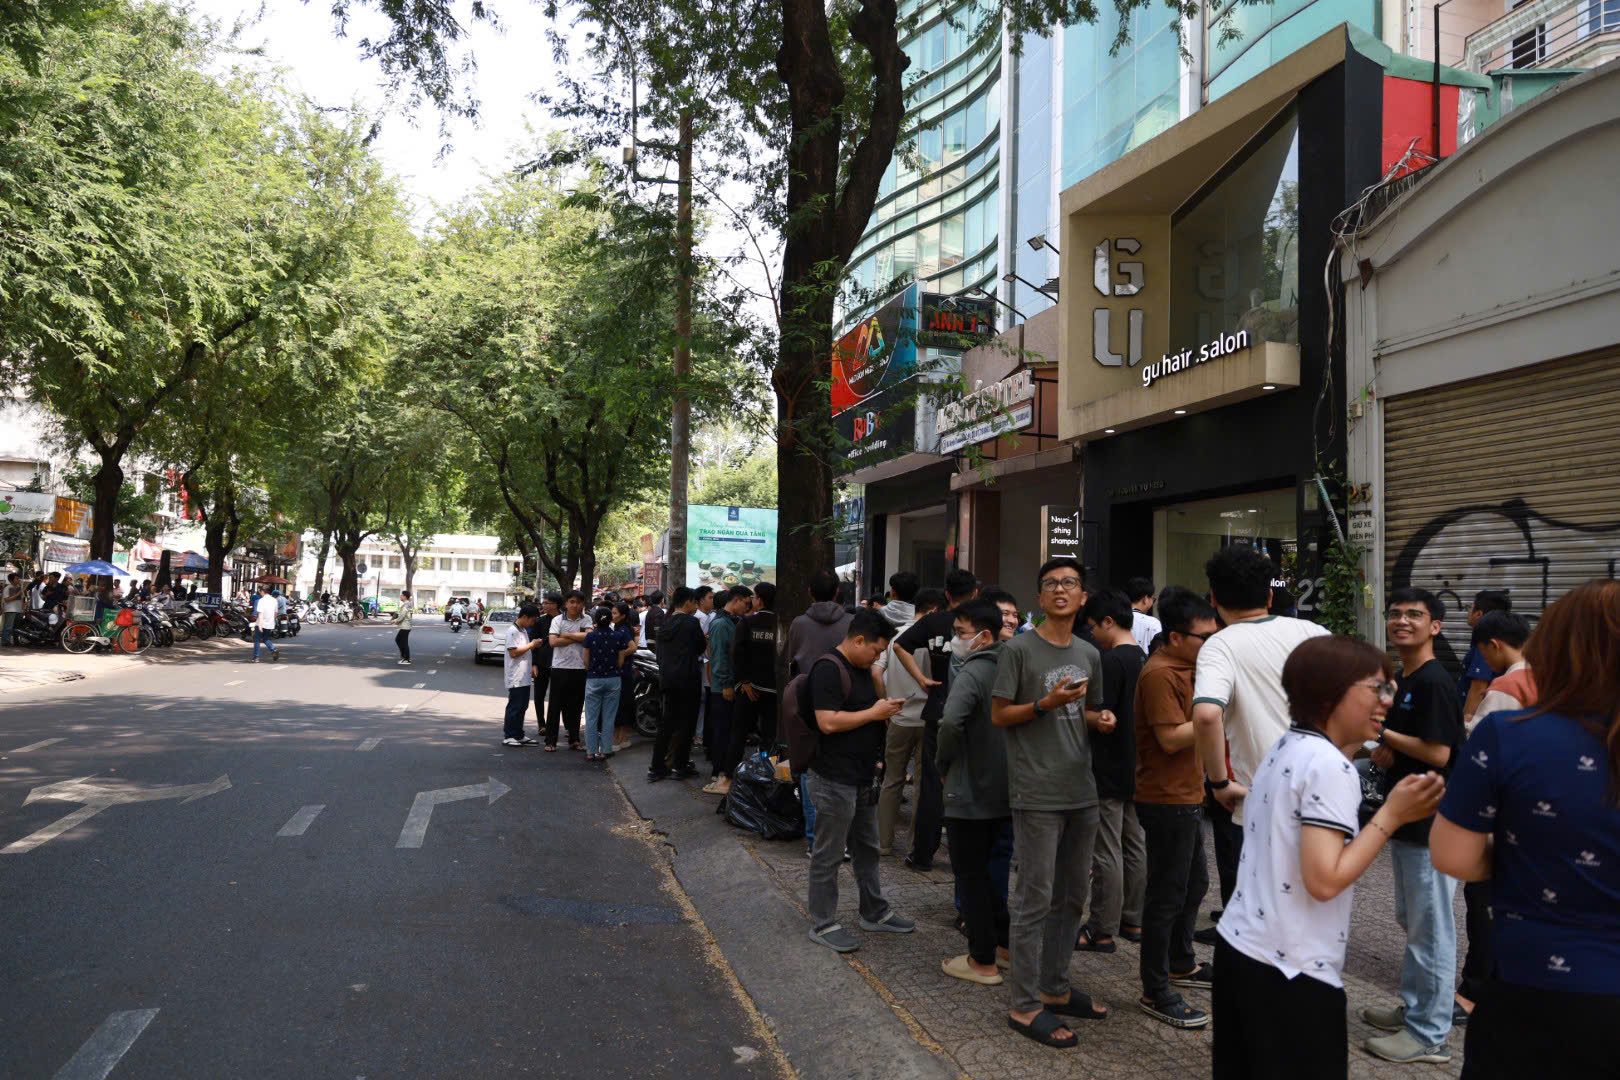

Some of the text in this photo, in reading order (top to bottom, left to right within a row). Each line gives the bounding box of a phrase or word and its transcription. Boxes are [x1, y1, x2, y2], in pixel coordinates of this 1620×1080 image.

[1142, 362, 1160, 387] gu
[1162, 347, 1192, 375] hair
[1051, 515, 1073, 524] Nouri-
[1051, 526, 1071, 536] -shing
[1050, 536, 1079, 547] shampoo
[1270, 578, 1286, 587] lon
[752, 631, 764, 640] THE
